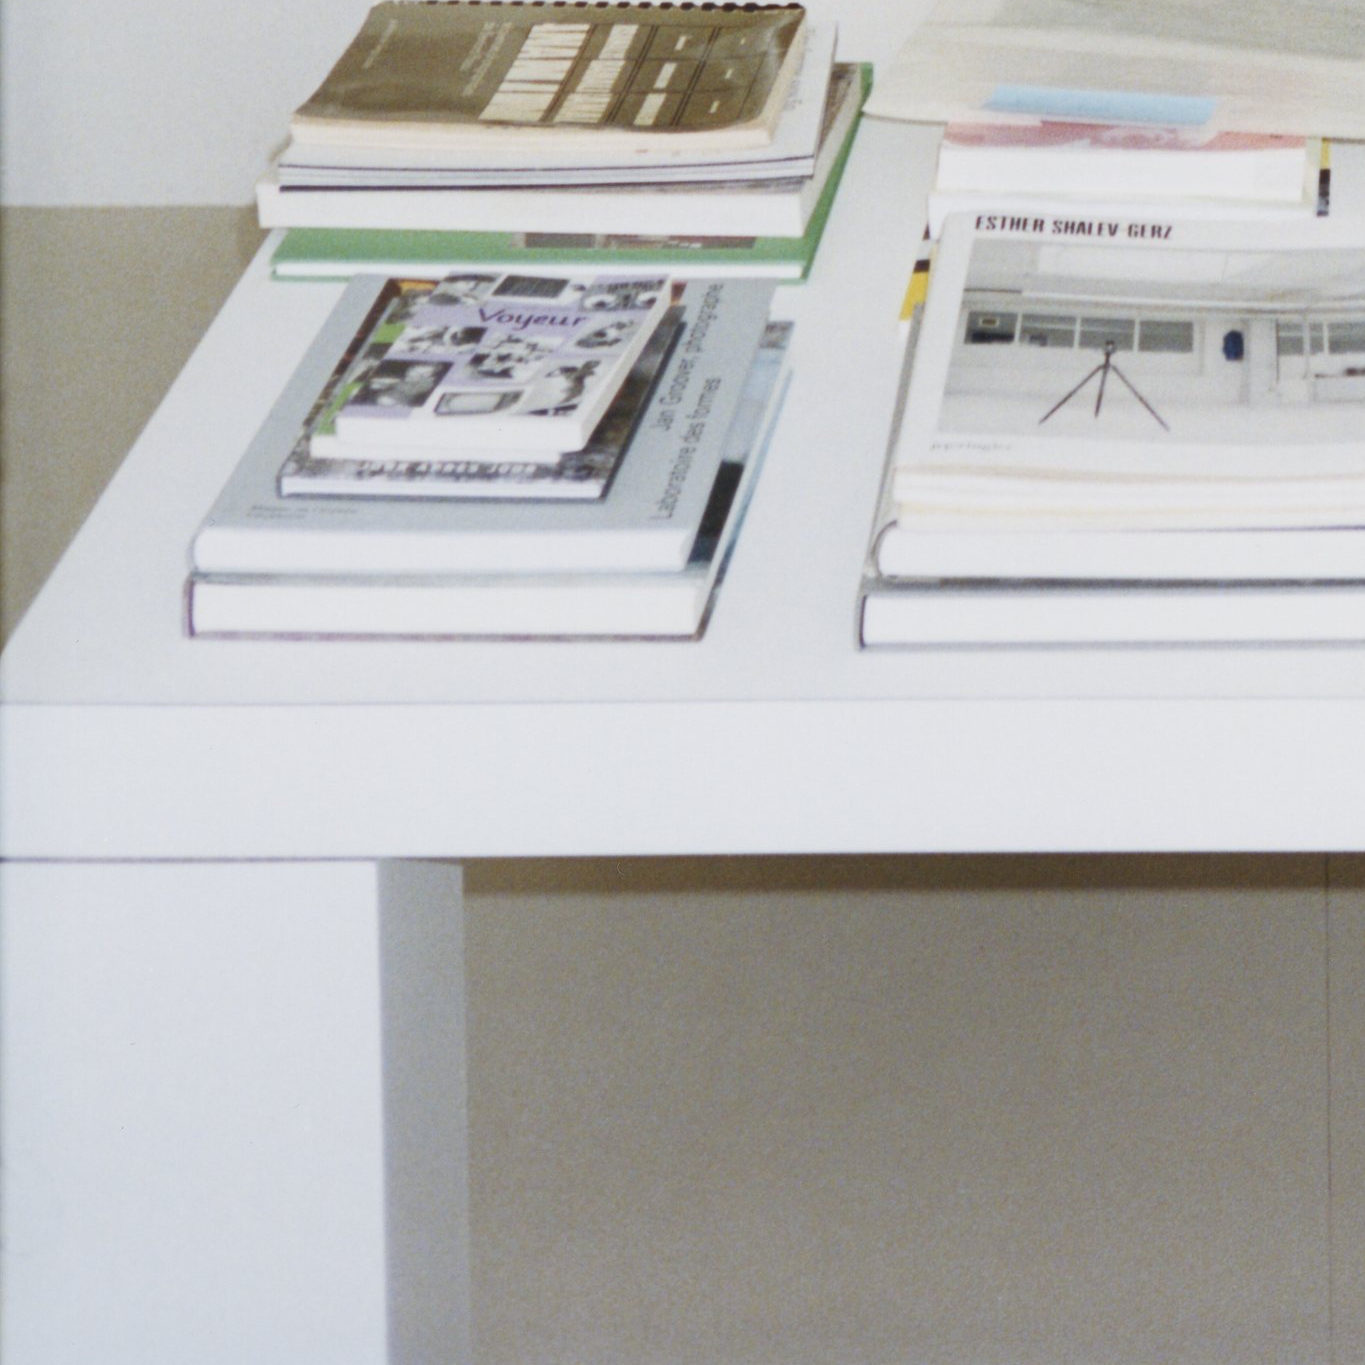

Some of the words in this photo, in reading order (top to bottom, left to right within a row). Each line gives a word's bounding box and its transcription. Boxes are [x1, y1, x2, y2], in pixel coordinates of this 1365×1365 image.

[975, 215, 1045, 233] ESTHER
[479, 307, 588, 331] Voyeur
[652, 410, 674, 431] Jan
[684, 283, 724, 353] photographe
[686, 378, 722, 419] formes
[682, 421, 706, 444] des
[651, 447, 696, 519] Laboratoire
